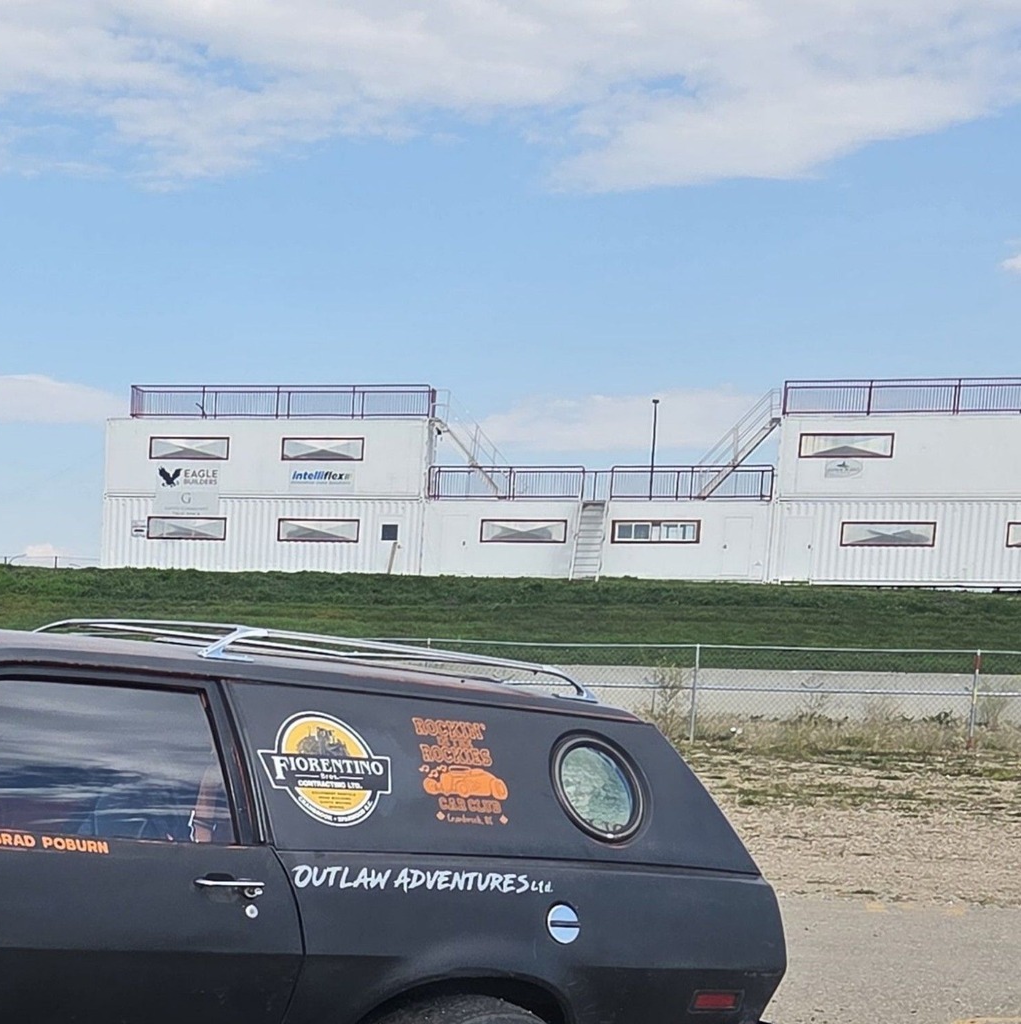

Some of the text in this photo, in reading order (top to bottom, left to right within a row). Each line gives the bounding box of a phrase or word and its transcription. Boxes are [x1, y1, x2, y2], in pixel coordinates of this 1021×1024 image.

[183, 469, 219, 478] EAGLE
[419, 744, 493, 767] ROCKIES
[271, 756, 384, 780] FIORENTINO
[297, 779, 346, 789] CONTRACTING
[438, 796, 503, 814] CAR CLUB
[41, 836, 110, 854] POBURN
[291, 864, 392, 891] OUTLAW
[393, 867, 529, 894] ADVENTURES
